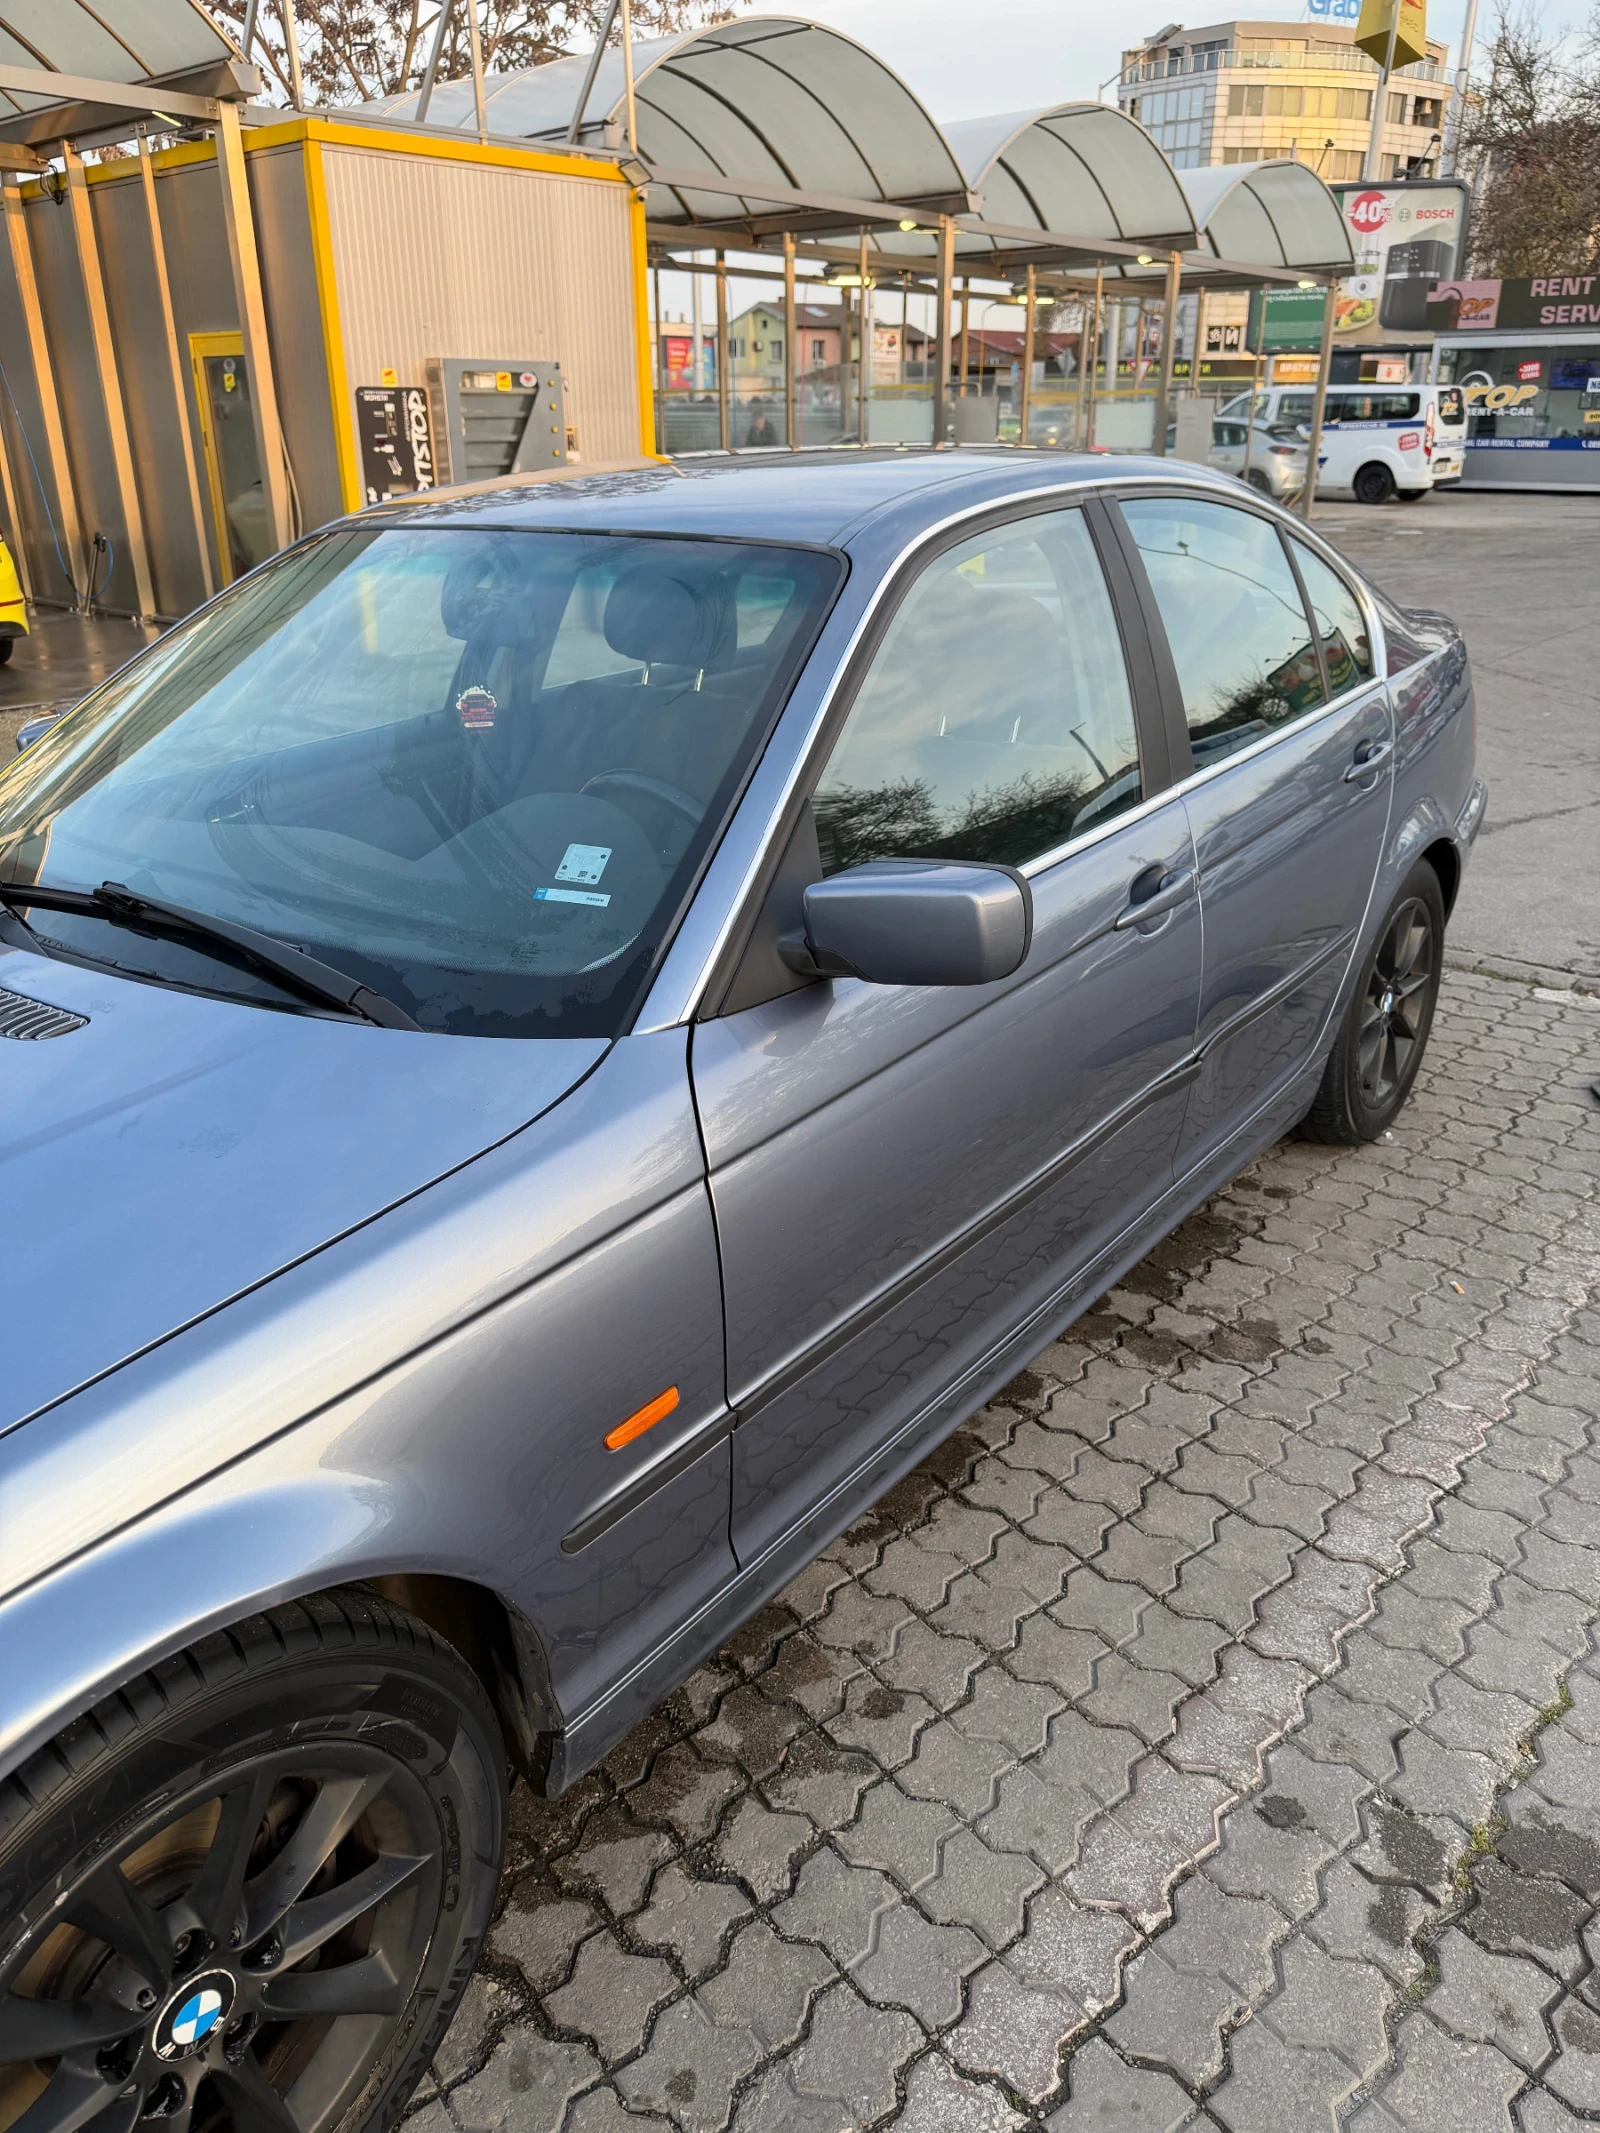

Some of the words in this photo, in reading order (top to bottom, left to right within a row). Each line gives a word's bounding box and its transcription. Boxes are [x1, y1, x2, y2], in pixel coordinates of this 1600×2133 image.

[1416, 209, 1455, 220] BOSCH
[1530, 276, 1597, 297] RENT
[1466, 385, 1539, 408] TOP
[1476, 439, 1490, 447] CAR
